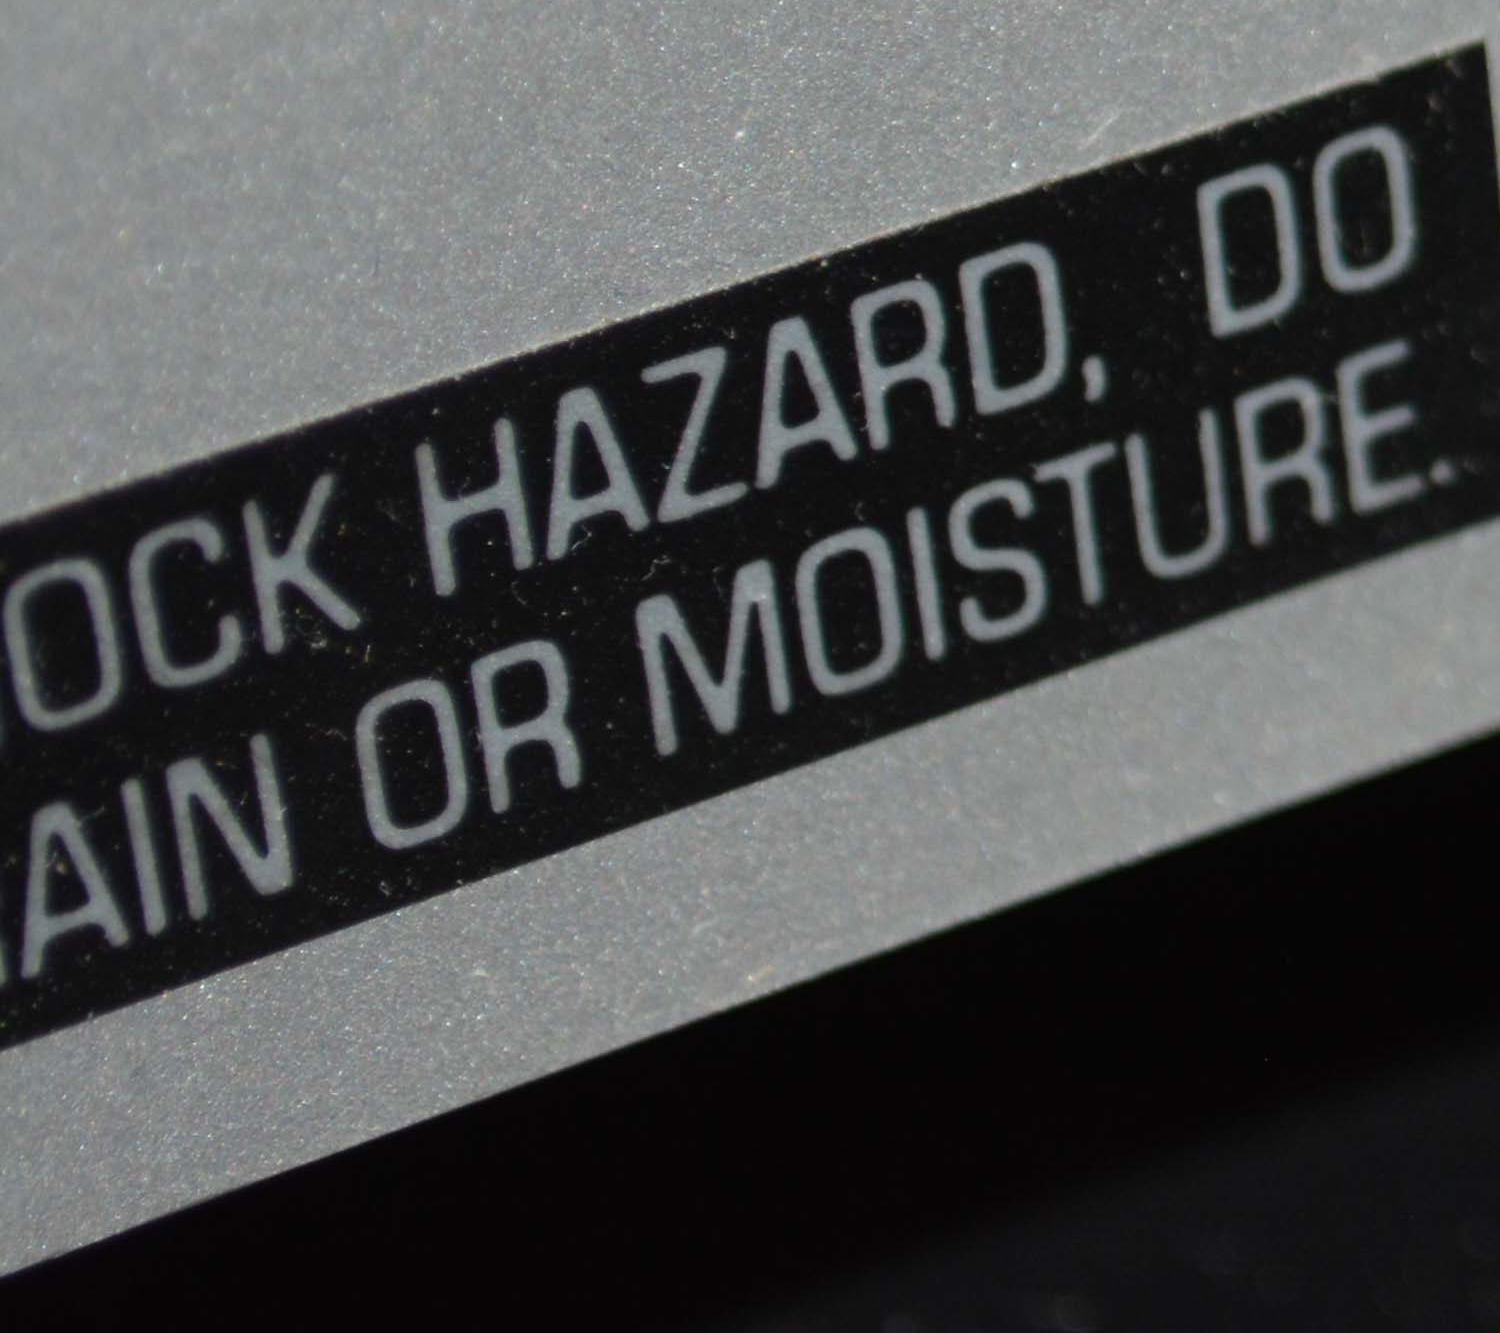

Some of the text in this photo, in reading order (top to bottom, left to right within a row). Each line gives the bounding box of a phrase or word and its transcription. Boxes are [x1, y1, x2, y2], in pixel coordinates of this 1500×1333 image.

[0, 123, 1422, 743] OCK HAZARD, DO
[0, 339, 1462, 991] AIN OR MOISTURE.
